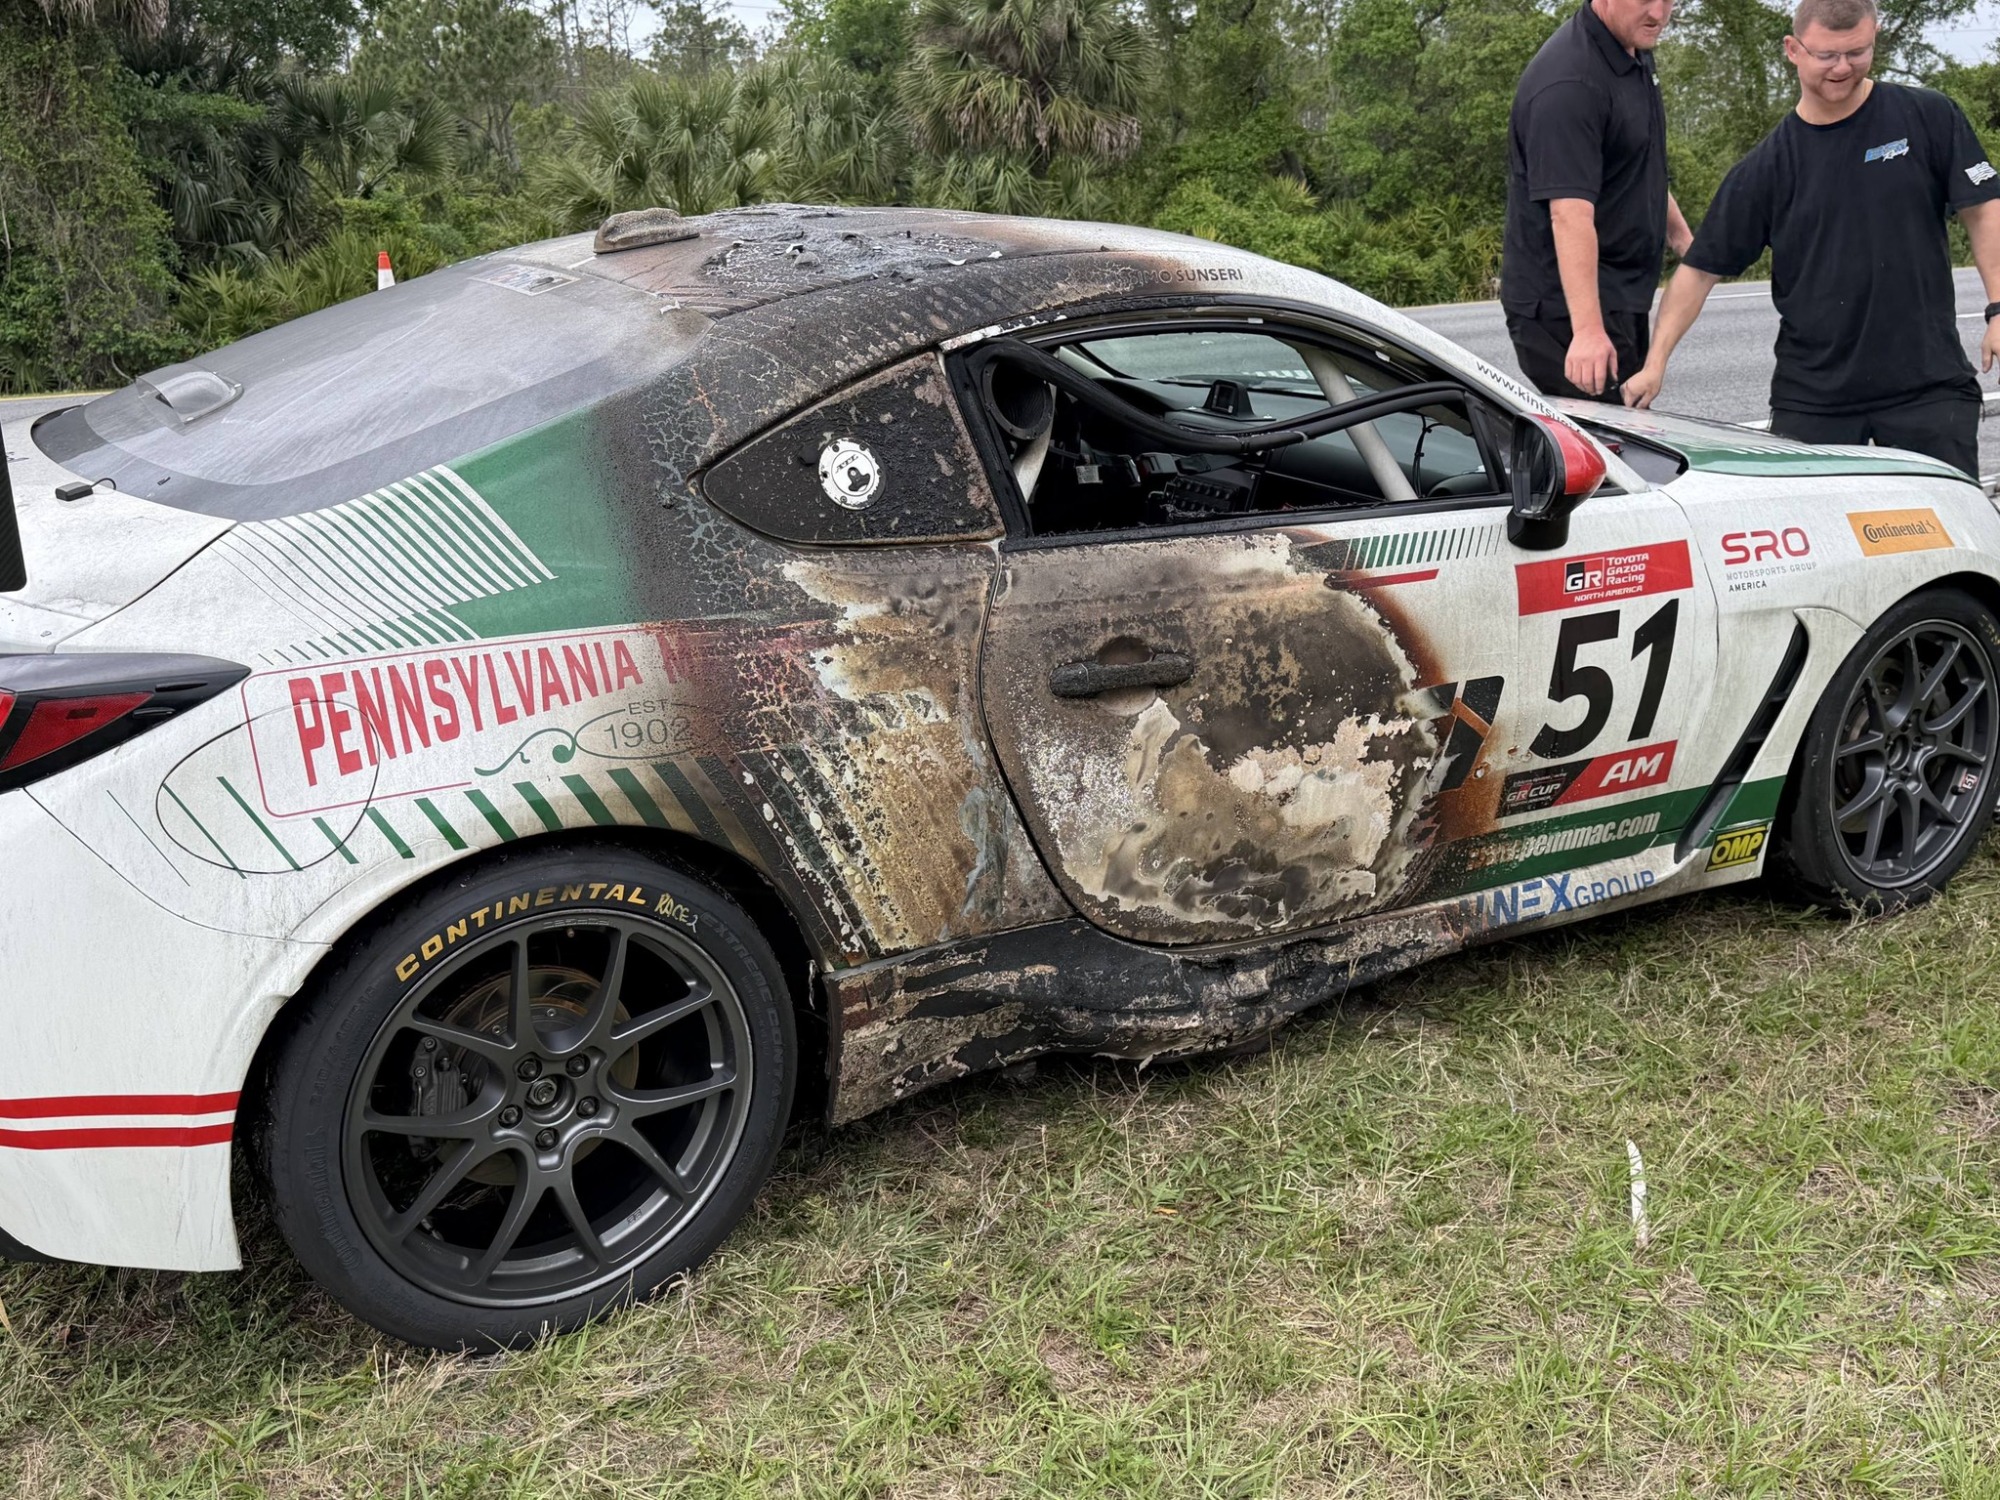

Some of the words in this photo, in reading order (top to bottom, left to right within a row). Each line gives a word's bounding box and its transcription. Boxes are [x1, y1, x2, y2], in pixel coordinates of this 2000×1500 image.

[1176, 268, 1243, 283] SUNSERI
[1863, 520, 1929, 543] Continental
[1721, 526, 1811, 566] SRO
[1606, 552, 1649, 566] TOYOTA
[1606, 563, 1646, 576] GAZOO
[1565, 571, 1602, 591] GR
[1605, 573, 1645, 587] Racing
[1726, 566, 1787, 580] MOTORSPORTS
[1789, 562, 1818, 573] GROUP
[1574, 591, 1605, 603] NORTH
[1605, 585, 1643, 598] AMERICA
[1728, 580, 1767, 593] AMERICA
[1529, 598, 1680, 759] 51
[288, 640, 644, 787] PENNSYLVANIA
[604, 716, 693, 749] 1902
[1598, 752, 1665, 788] AM
[1711, 832, 1764, 864] OMP
[654, 892, 690, 923] RACE
[394, 882, 647, 982] CONTINENTAL
